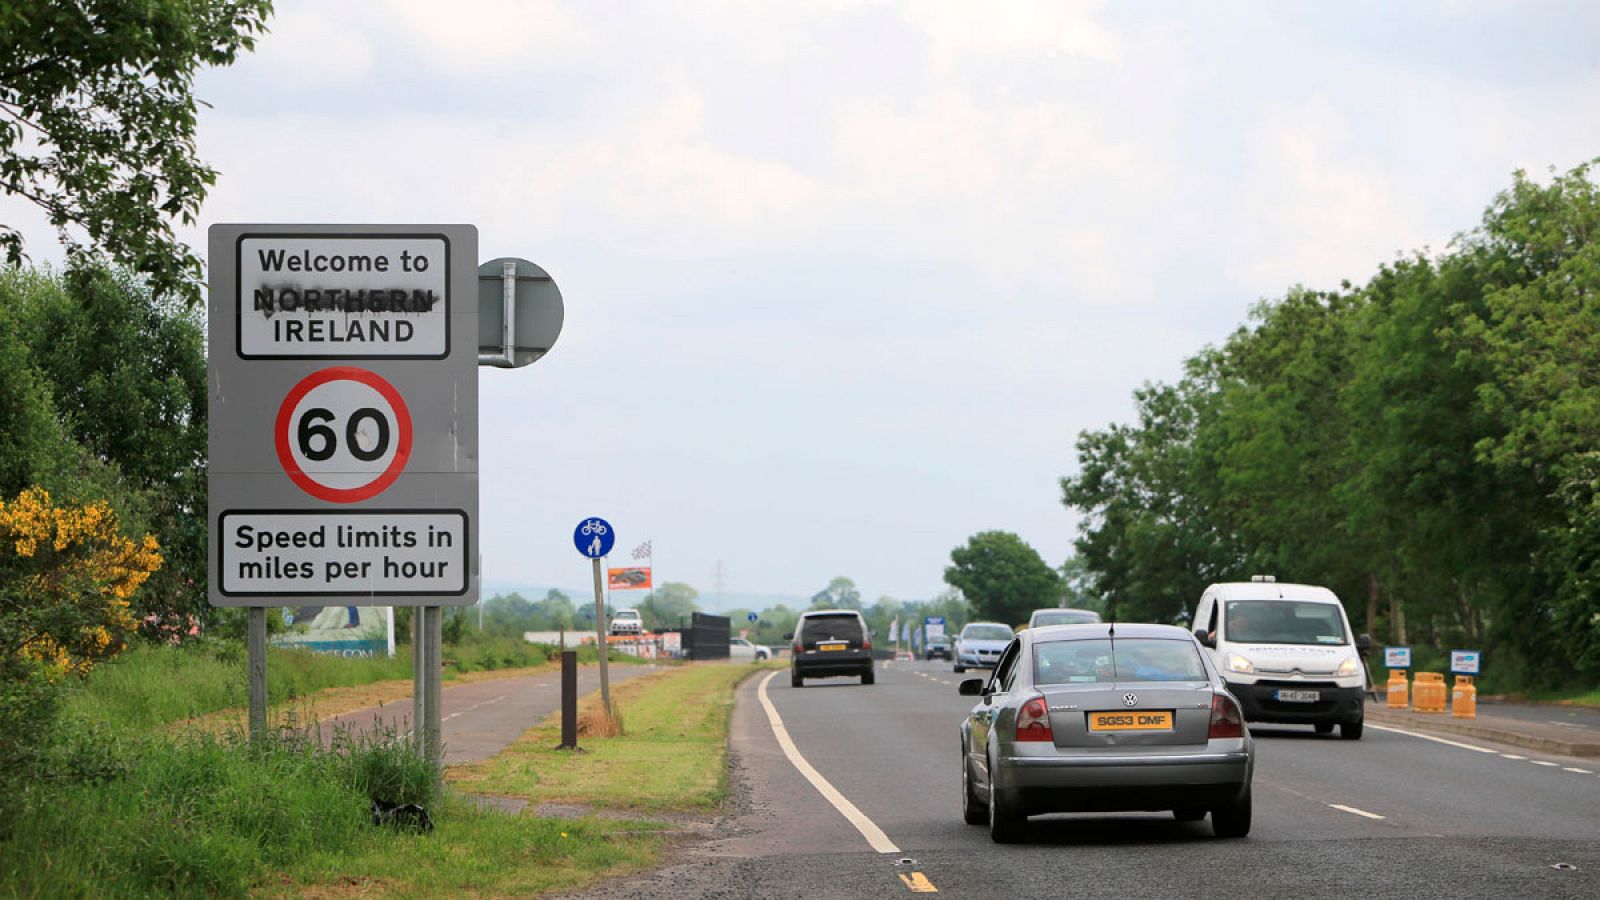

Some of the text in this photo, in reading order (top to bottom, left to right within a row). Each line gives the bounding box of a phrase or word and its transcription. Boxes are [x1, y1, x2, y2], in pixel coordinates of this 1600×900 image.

[258, 249, 429, 273] Welcome to
[253, 289, 433, 313] NORTHERN
[274, 320, 414, 343] IRELAND
[297, 407, 391, 462] 60
[235, 525, 453, 549] Speed limits in
[239, 556, 449, 583] miles per hour
[1138, 715, 1166, 725] DMF
